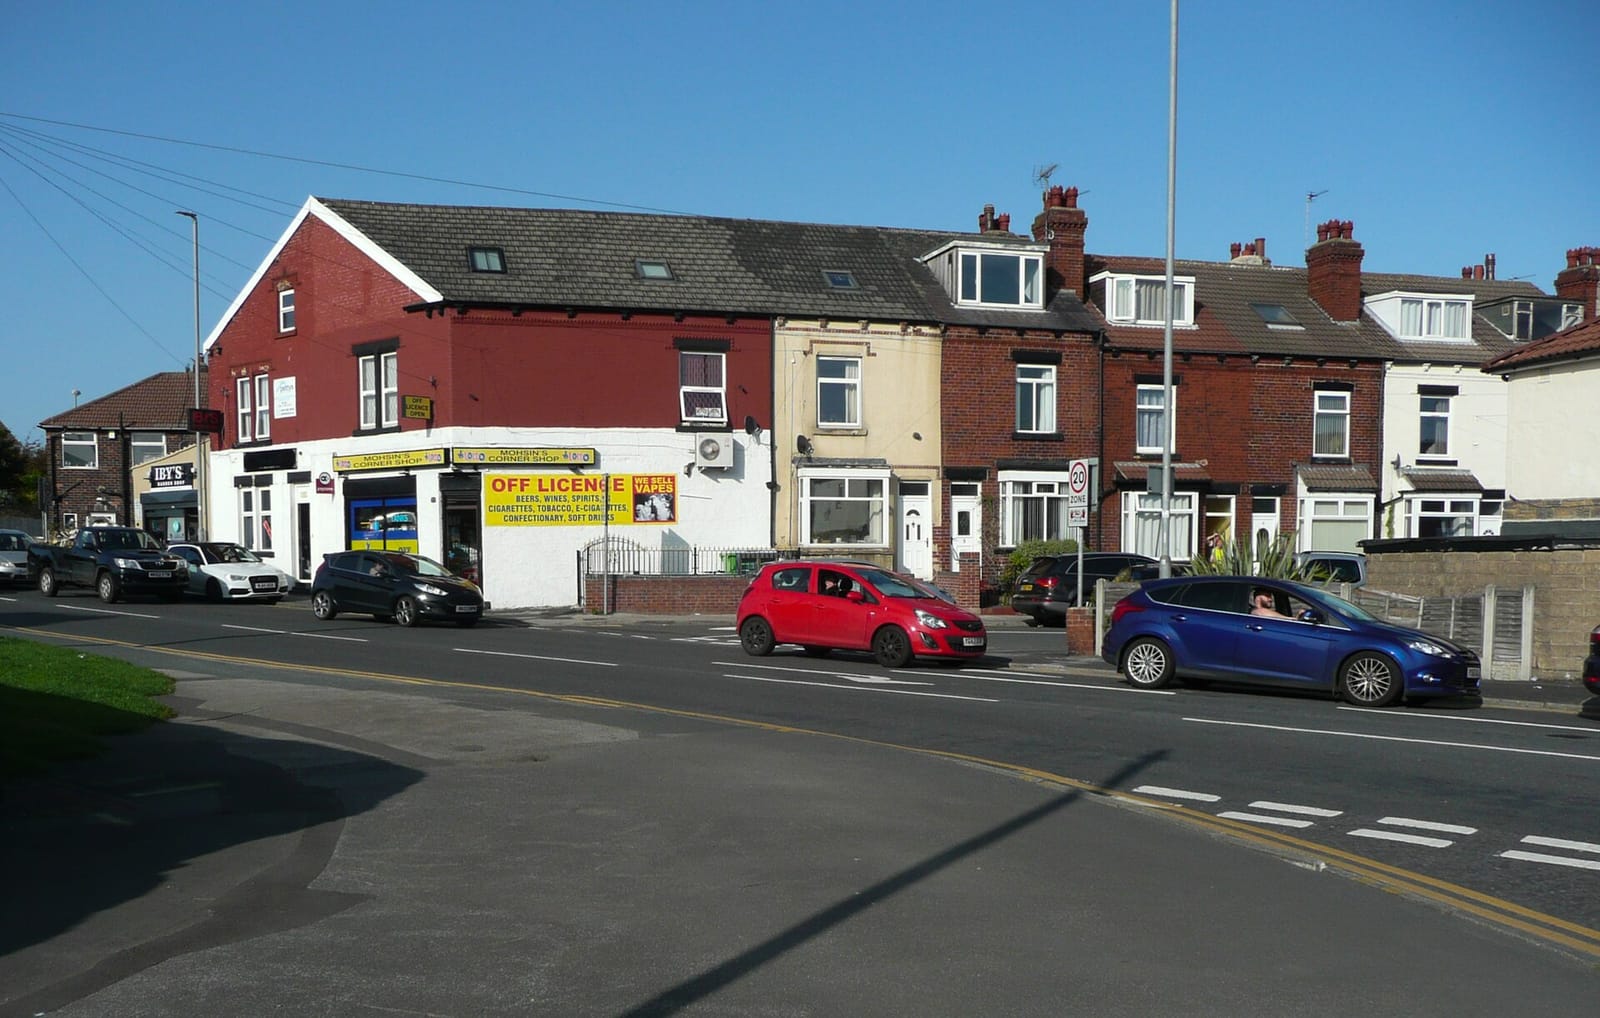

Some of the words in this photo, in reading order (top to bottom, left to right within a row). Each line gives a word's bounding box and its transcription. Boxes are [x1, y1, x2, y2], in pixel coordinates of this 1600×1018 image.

[363, 453, 410, 461] MOHSIN'S
[353, 460, 393, 468] CORNER
[394, 457, 422, 465] SHOP
[155, 465, 182, 480] IBY'S
[1073, 471, 1085, 484] 20
[492, 478, 530, 492] OFF
[635, 485, 674, 493] VAPES
[516, 495, 542, 503] BEERS,
[544, 495, 570, 503] WINES,
[1070, 495, 1086, 504] ZONE
[488, 505, 535, 513] CIGARETTES,
[538, 505, 574, 513] TOBACCO,
[503, 514, 566, 523] CONFECTIONARY,
[568, 514, 587, 522] SOFT
